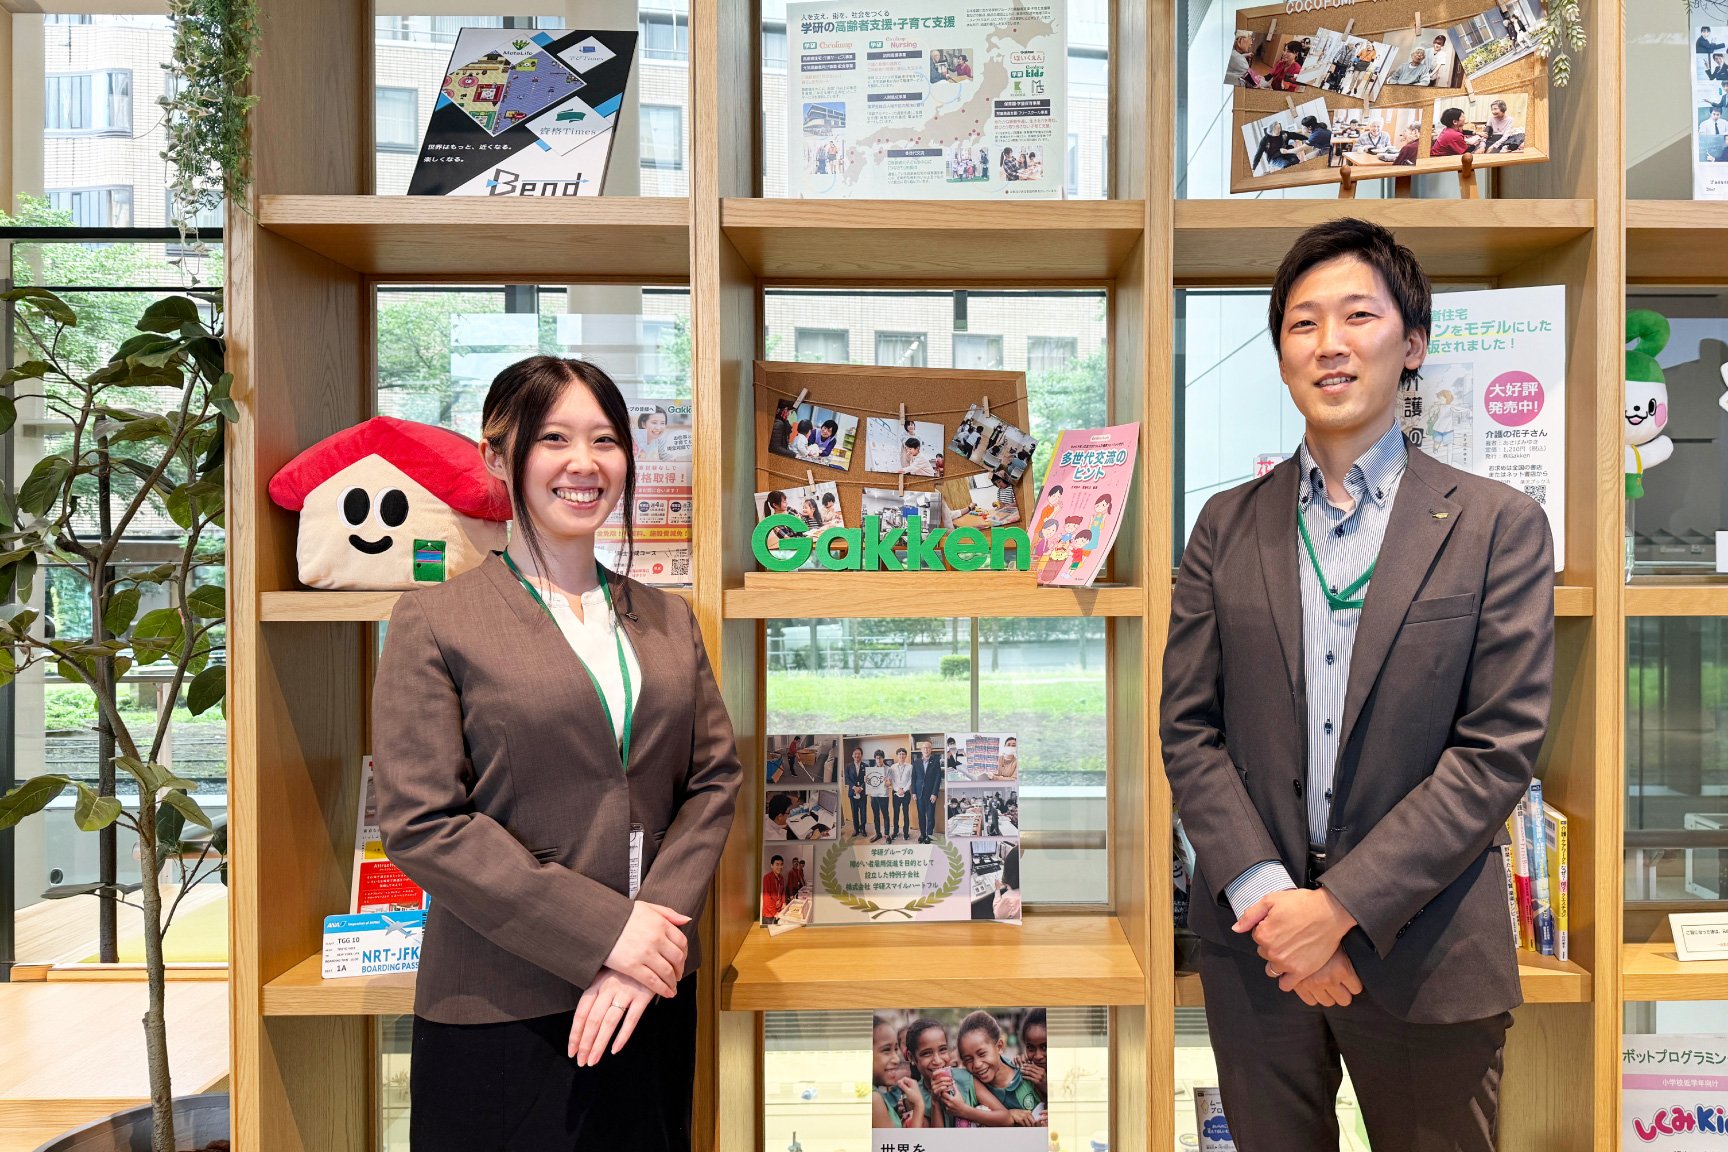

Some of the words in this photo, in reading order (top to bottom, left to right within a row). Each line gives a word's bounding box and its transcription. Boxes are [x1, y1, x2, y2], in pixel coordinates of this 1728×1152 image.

[801, 16, 955, 34] 学研の高齢者支援・子育て支援
[1026, 69, 1044, 77] kids
[540, 127, 596, 136] 資格Times
[489, 168, 583, 196] Bend
[1489, 382, 1539, 398] 大好評
[668, 404, 692, 413] Gakk
[1489, 401, 1538, 415] 発売中!
[1485, 429, 1548, 438] 介護の花子さん
[1060, 450, 1127, 466] 多世代交流の
[1073, 466, 1105, 480] ヒント
[751, 515, 1031, 572] Gakken
[871, 848, 913, 856] 学研グループの
[864, 870, 920, 879] 設立した特例子会社
[846, 882, 870, 890] 株式会社
[362, 946, 420, 963] NRT-JFK
[362, 964, 400, 973] BOARDING
[1622, 1048, 1728, 1065] ボットプログラミン
